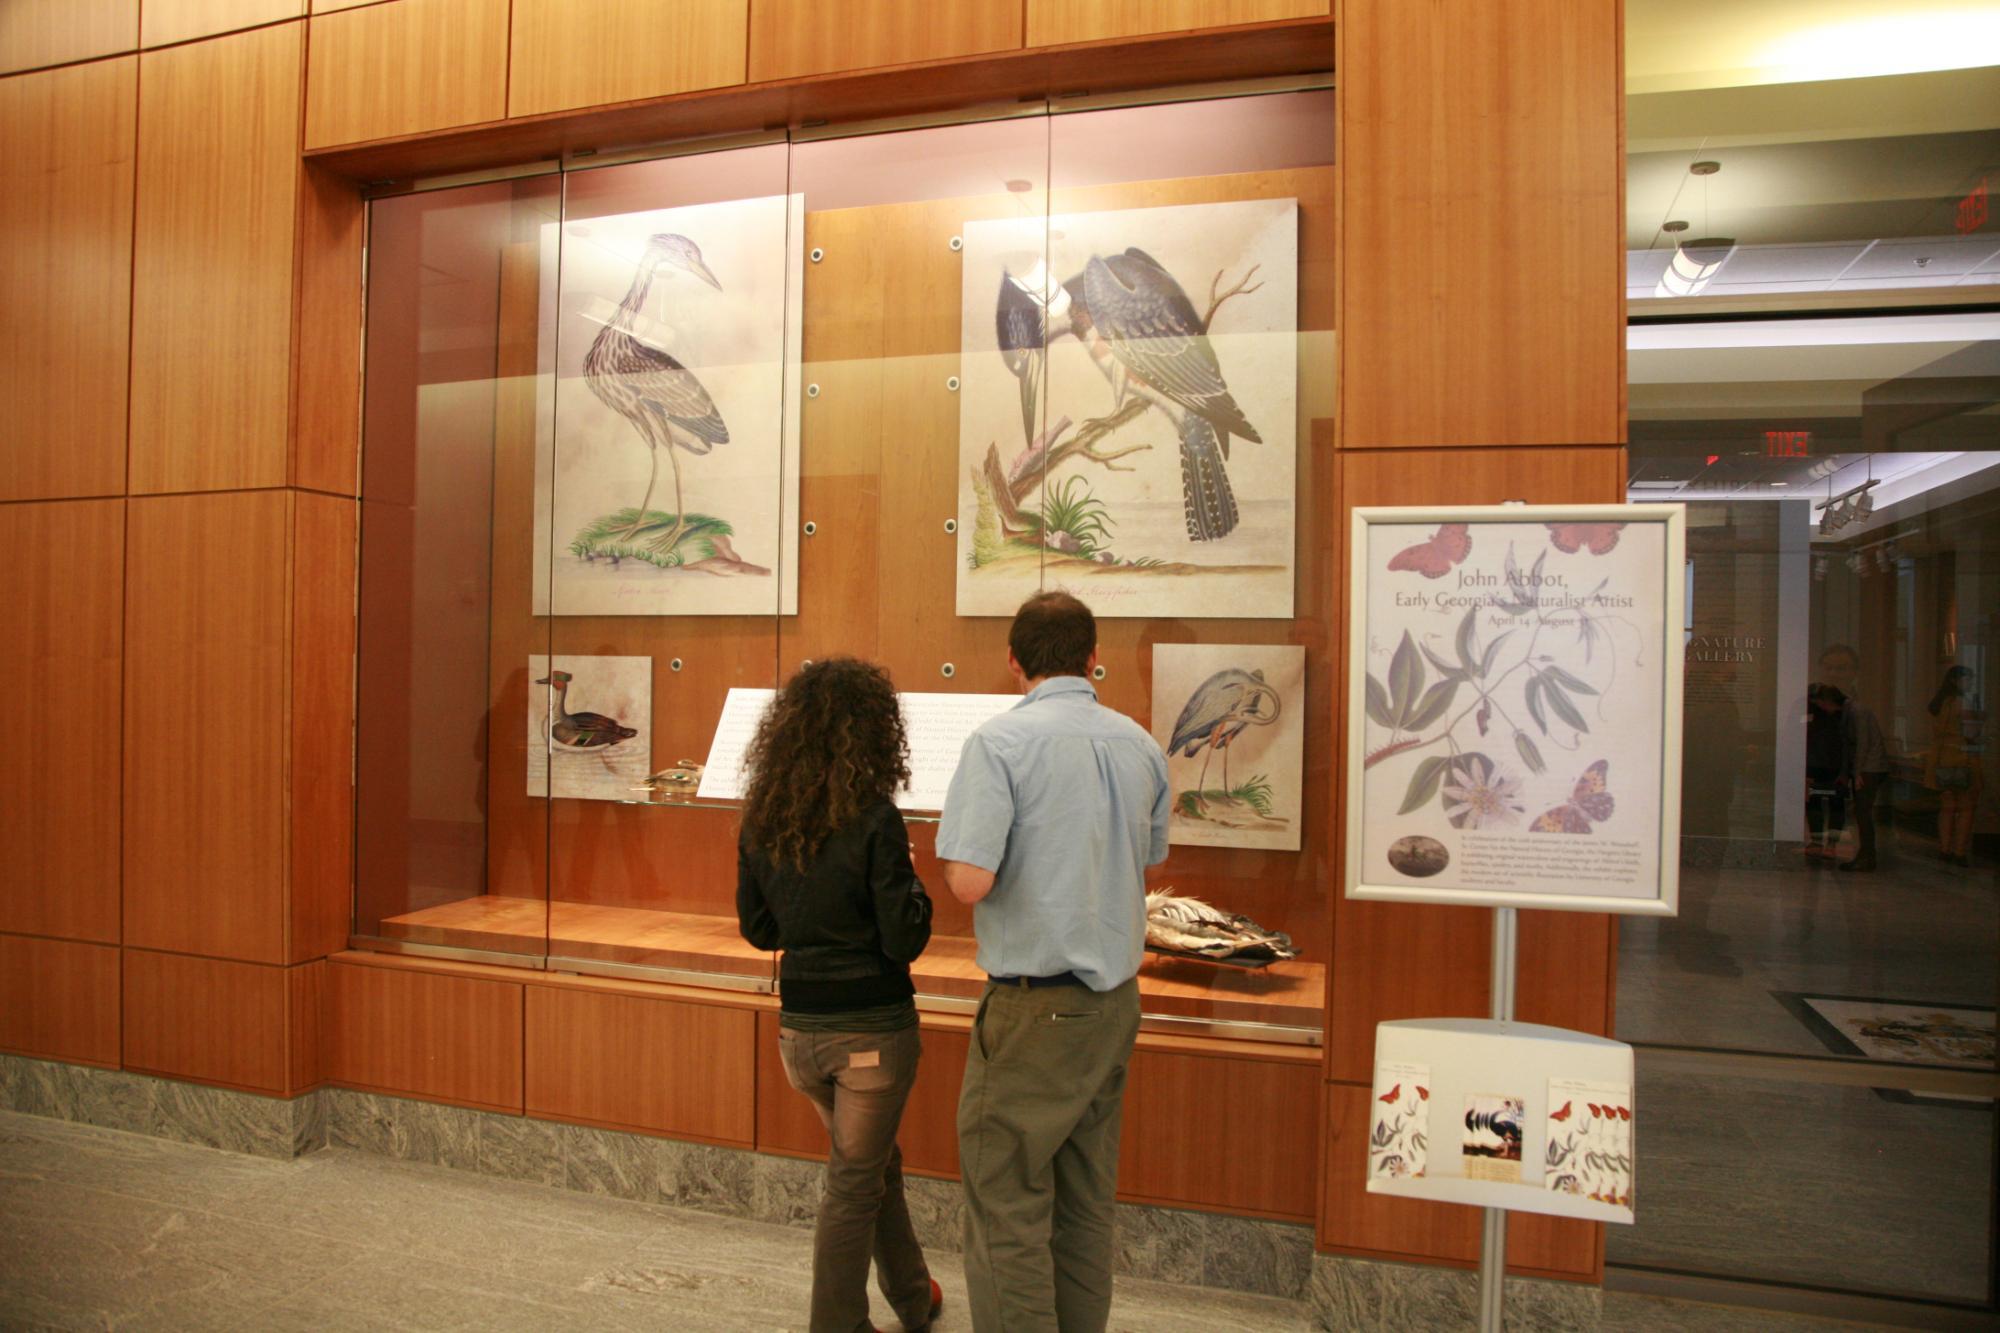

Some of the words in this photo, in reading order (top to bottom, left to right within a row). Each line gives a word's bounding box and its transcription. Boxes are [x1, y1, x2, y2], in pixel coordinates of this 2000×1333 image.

[1458, 568, 1497, 590] John
[1504, 568, 1568, 589] Abbot,
[1395, 591, 1429, 611] Early
[1435, 591, 1506, 611] Georgia's
[1513, 591, 1585, 608] Naturalist
[1592, 593, 1633, 608] Artist
[1488, 615, 1515, 628] April
[1688, 636, 1766, 649] GNATURE
[1687, 650, 1754, 662] ALLERY
